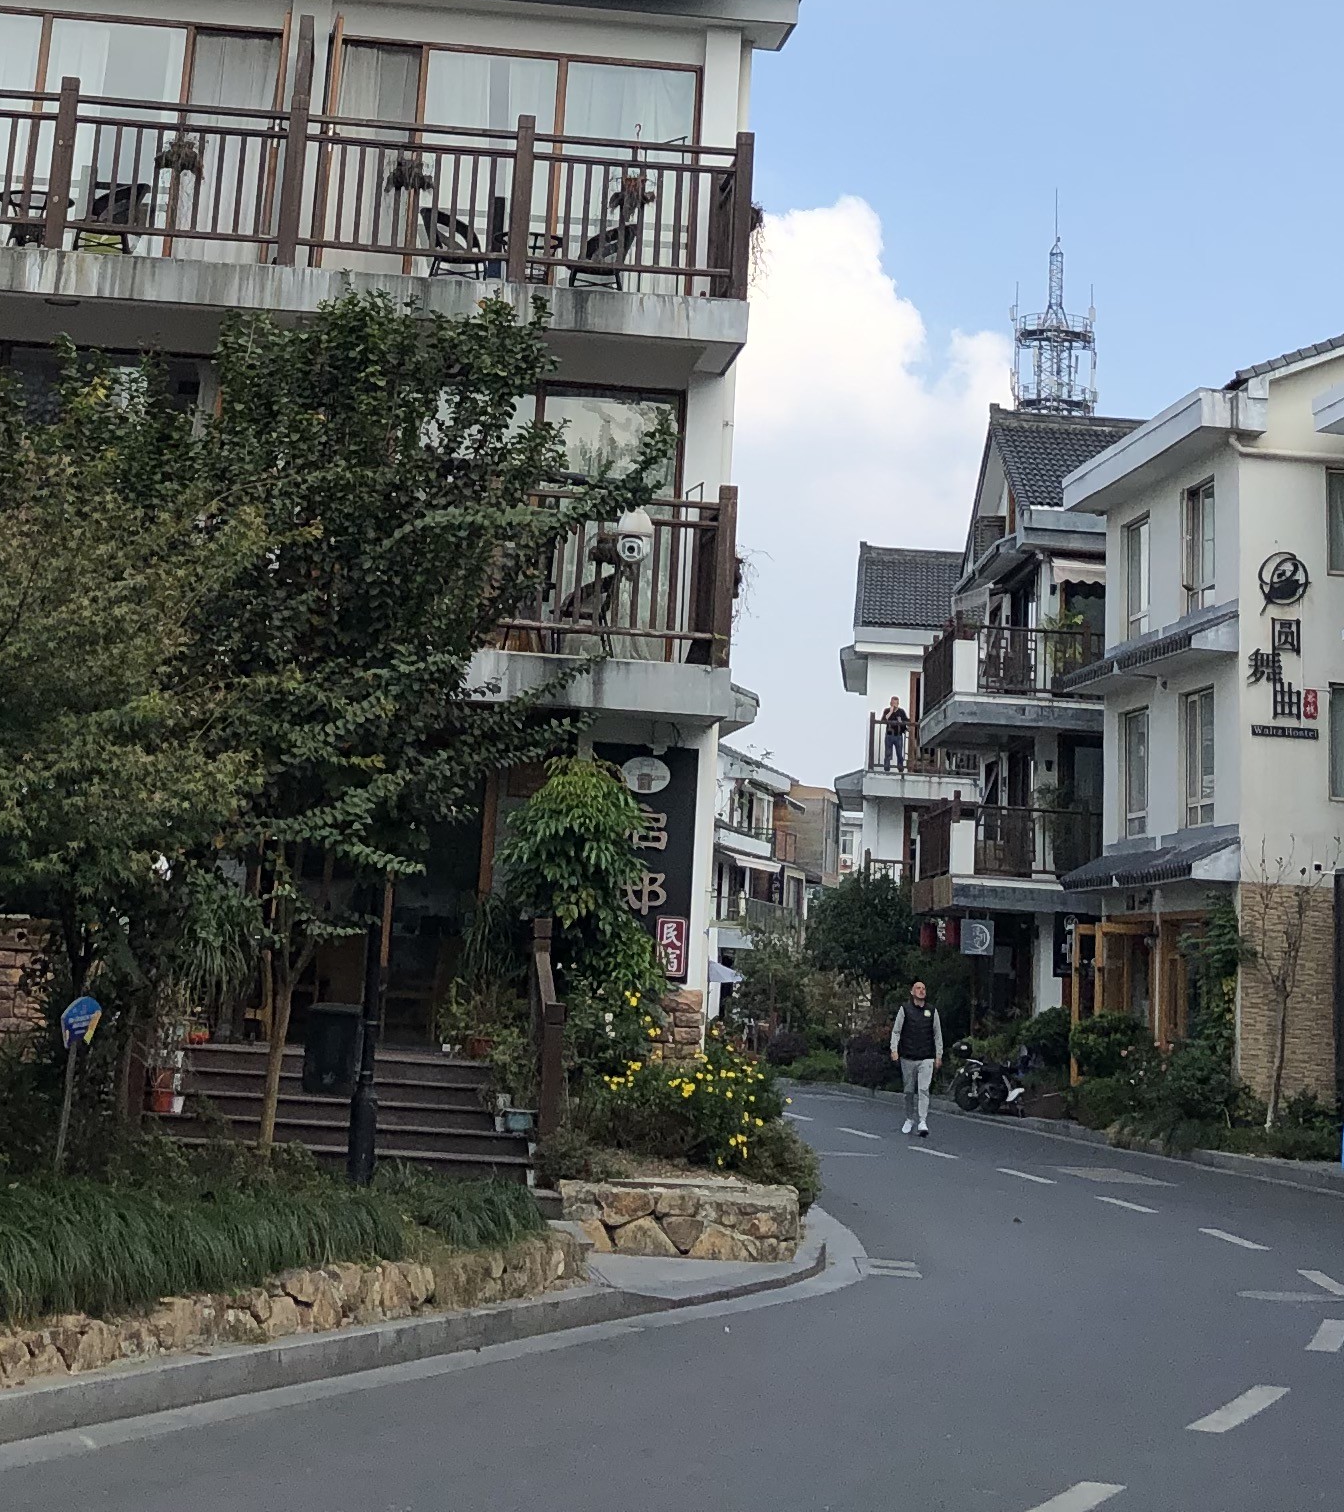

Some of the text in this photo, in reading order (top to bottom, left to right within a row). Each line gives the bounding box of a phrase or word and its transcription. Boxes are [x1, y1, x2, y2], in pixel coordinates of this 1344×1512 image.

[1247, 617, 1302, 720] 圆舞曲
[1285, 728, 1318, 738] Hostel
